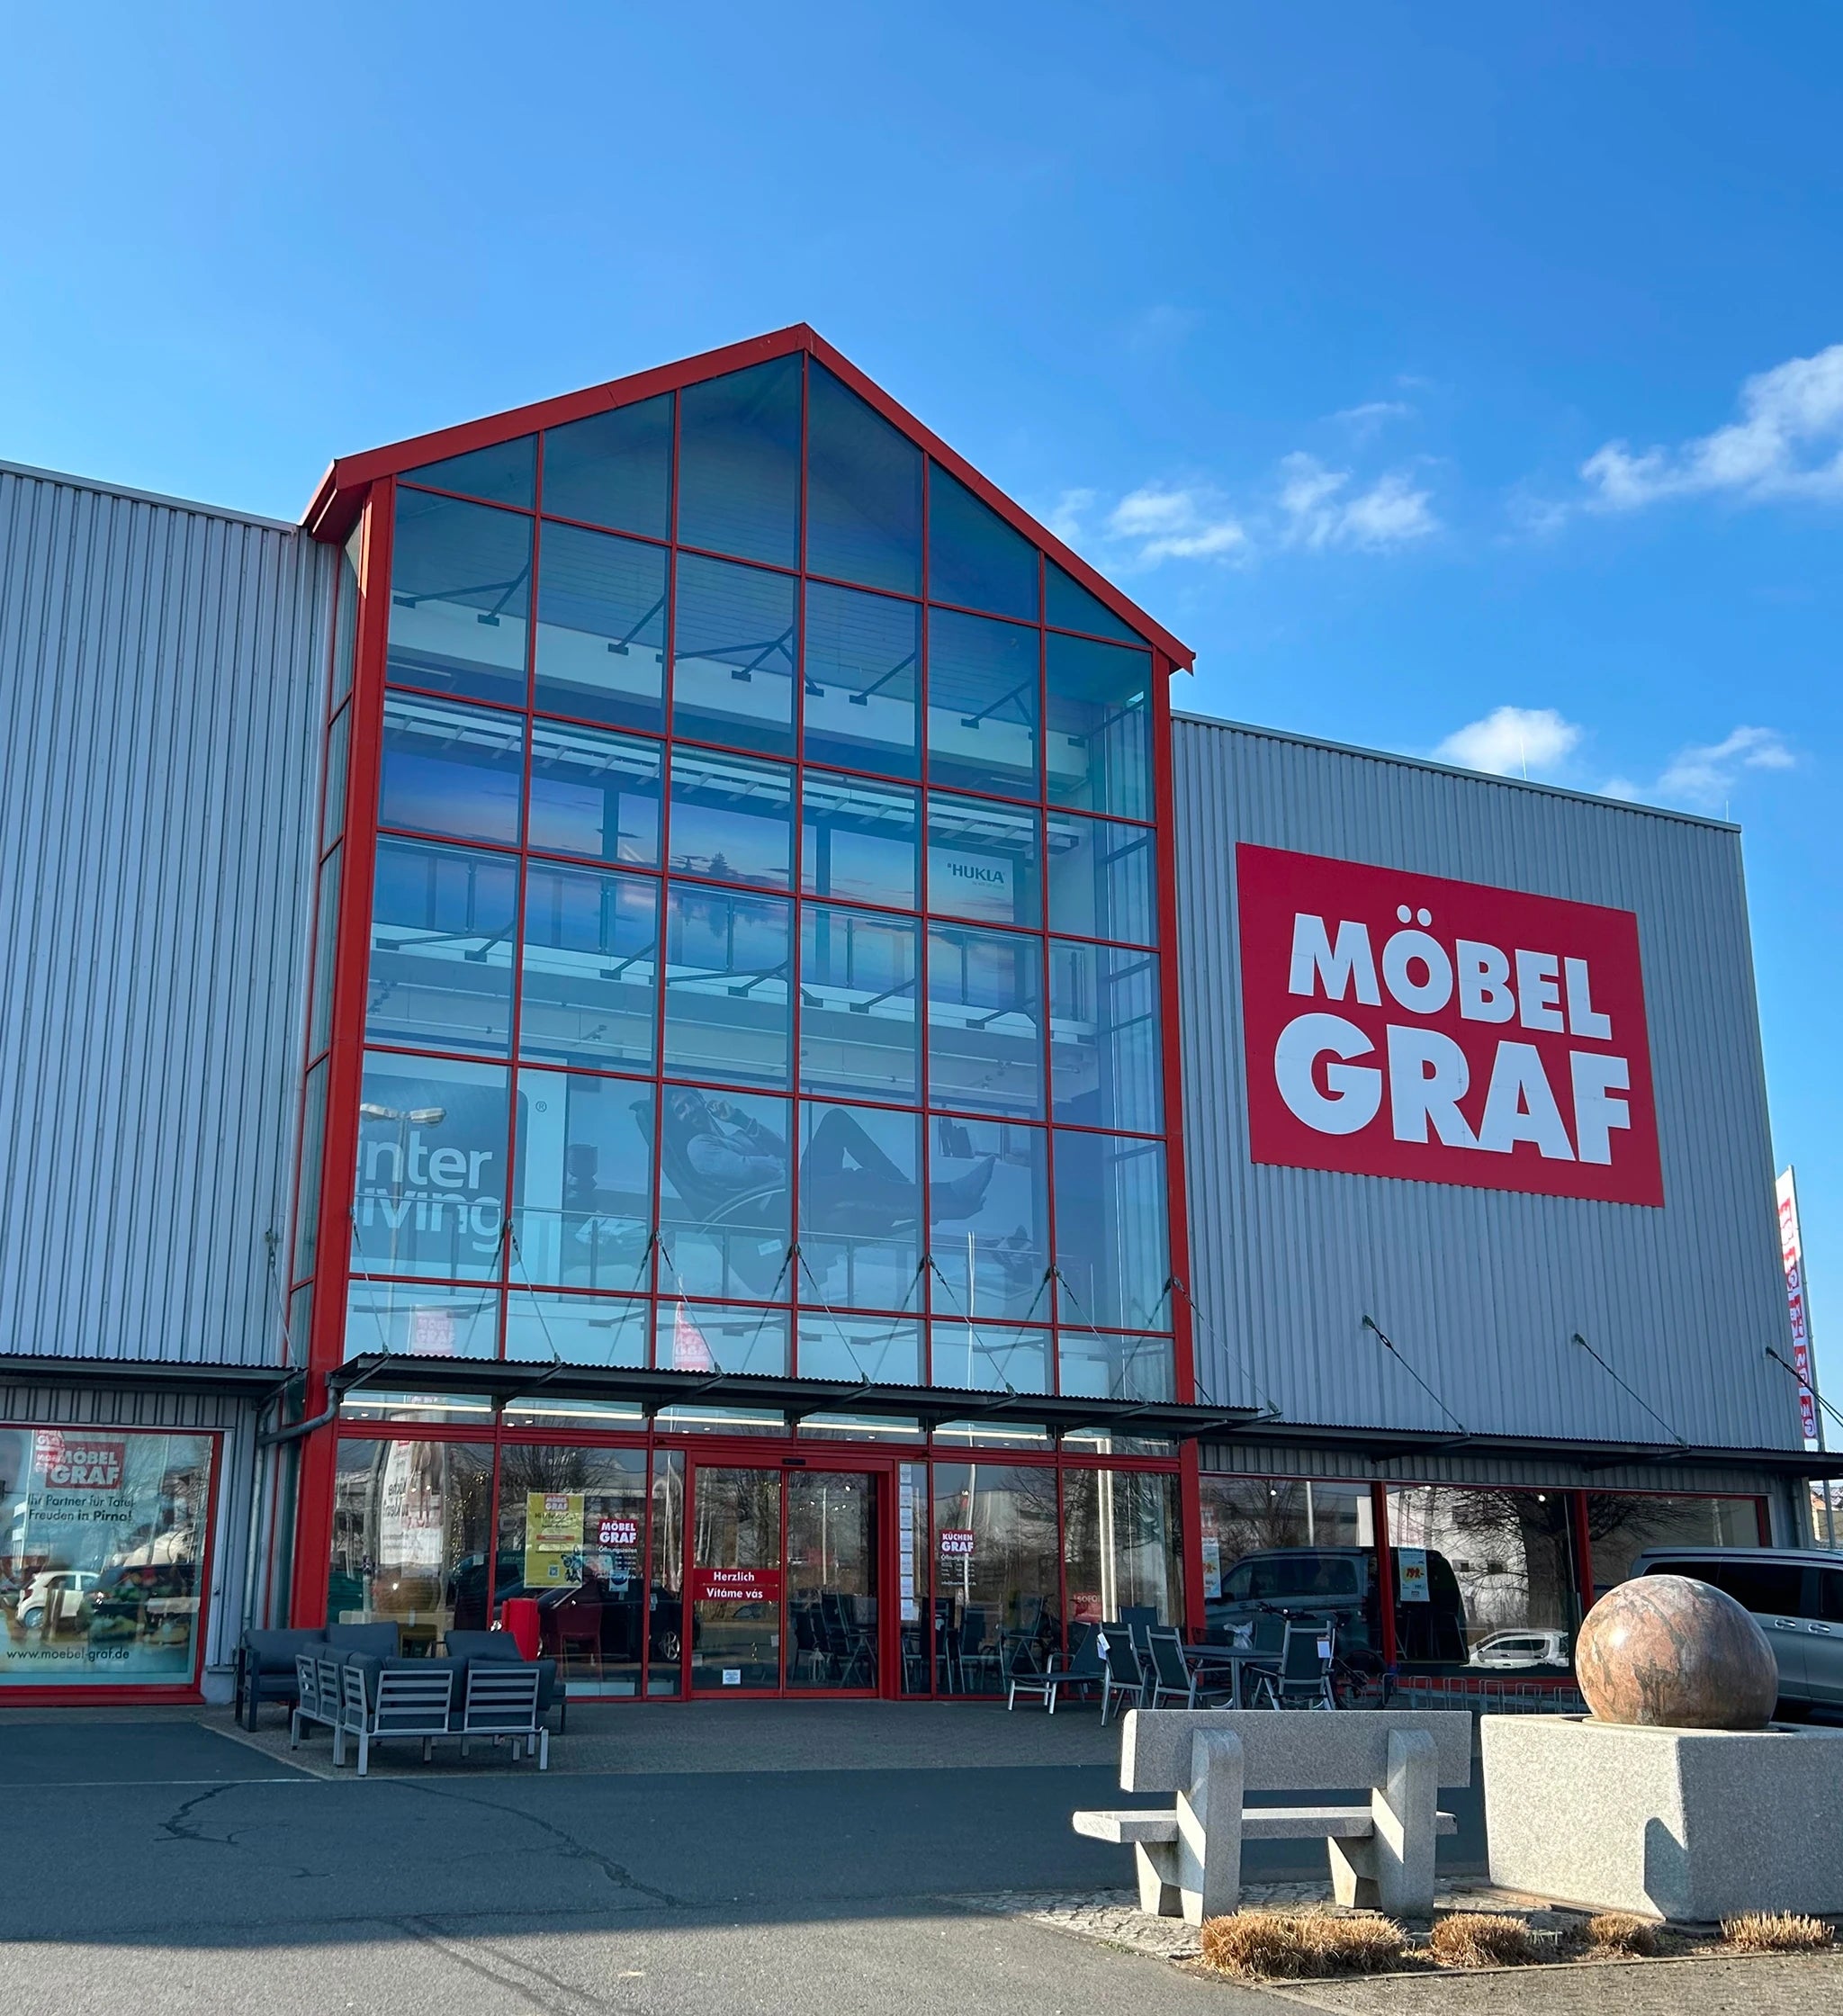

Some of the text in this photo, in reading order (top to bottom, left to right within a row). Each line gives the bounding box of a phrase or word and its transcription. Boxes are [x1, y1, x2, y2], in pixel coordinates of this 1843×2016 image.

[952, 863, 1004, 884] HUKLA
[1288, 904, 1613, 1040] MÖBEL
[1274, 1012, 1631, 1166] GRAF
[50, 1466, 120, 1485] GRAF
[46, 1495, 87, 1507] Partner
[90, 1495, 105, 1508] für
[545, 1502, 569, 1510] GRAF
[29, 1509, 132, 1522] Freuden in Pirna!
[601, 1521, 636, 1531] MÖBEL
[599, 1531, 637, 1544] GRAF
[942, 1532, 973, 1541] KÜCHEN
[941, 1541, 974, 1552] GRAF
[714, 1571, 755, 1581] Herzlich
[706, 1587, 763, 1598] Vítáme vás
[6, 1646, 130, 1662] www.moebel-graf.de
